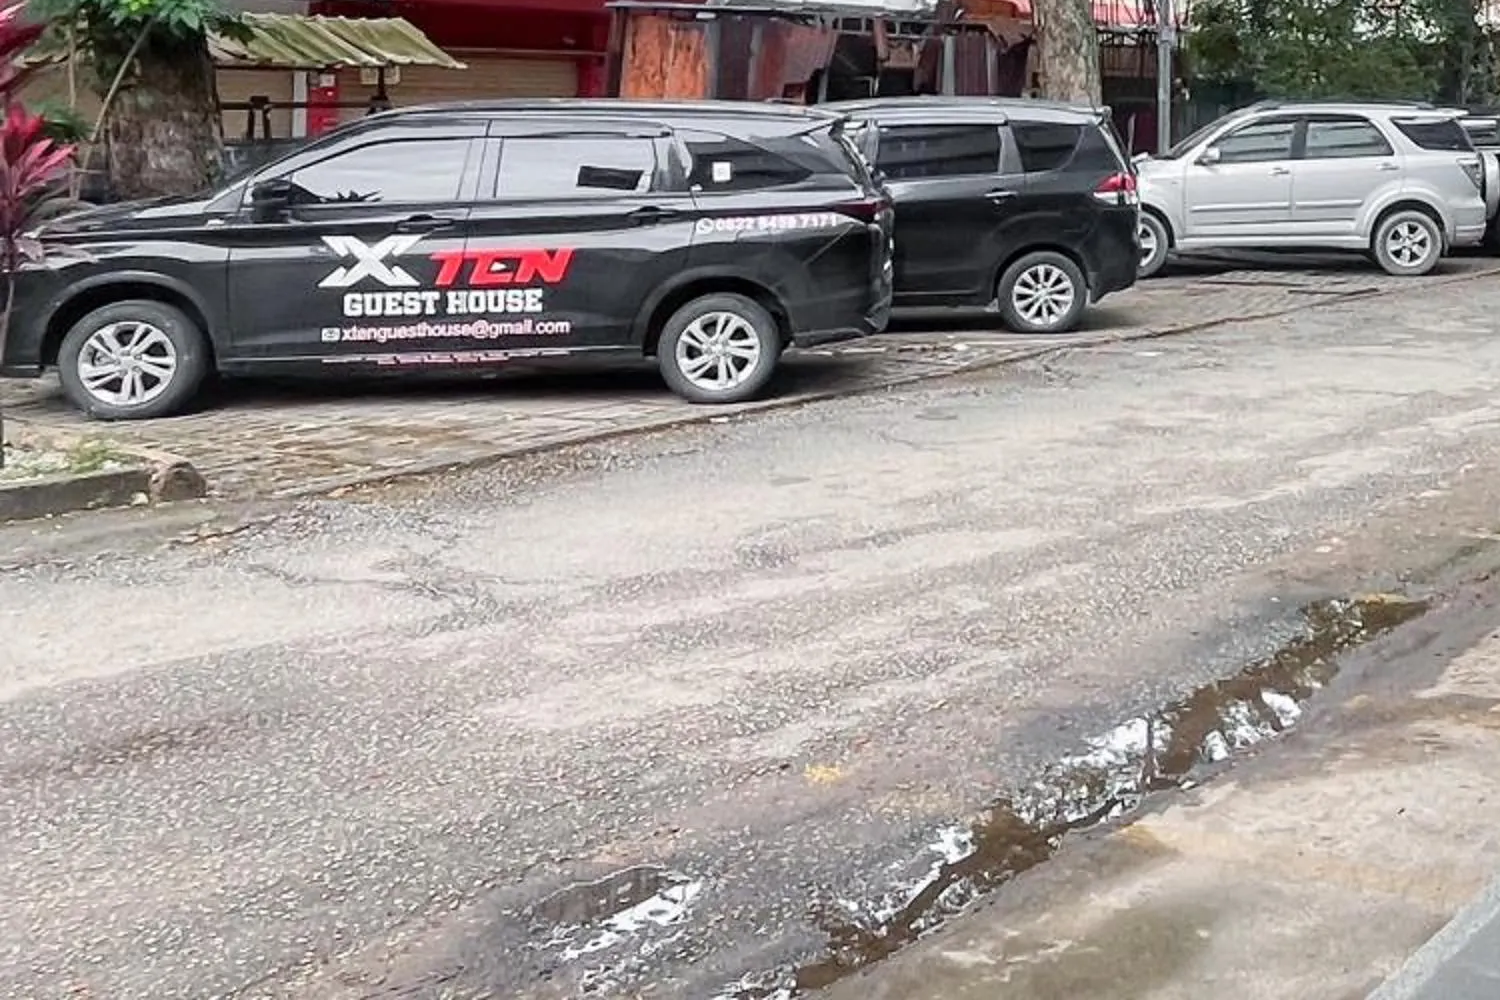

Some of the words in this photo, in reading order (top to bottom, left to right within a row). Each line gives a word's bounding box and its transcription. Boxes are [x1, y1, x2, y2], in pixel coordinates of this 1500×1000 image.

[343, 290, 440, 317] GUEST
[446, 288, 543, 315] HOUSE
[341, 319, 571, 343] xtenguesthouse@gmail.com
